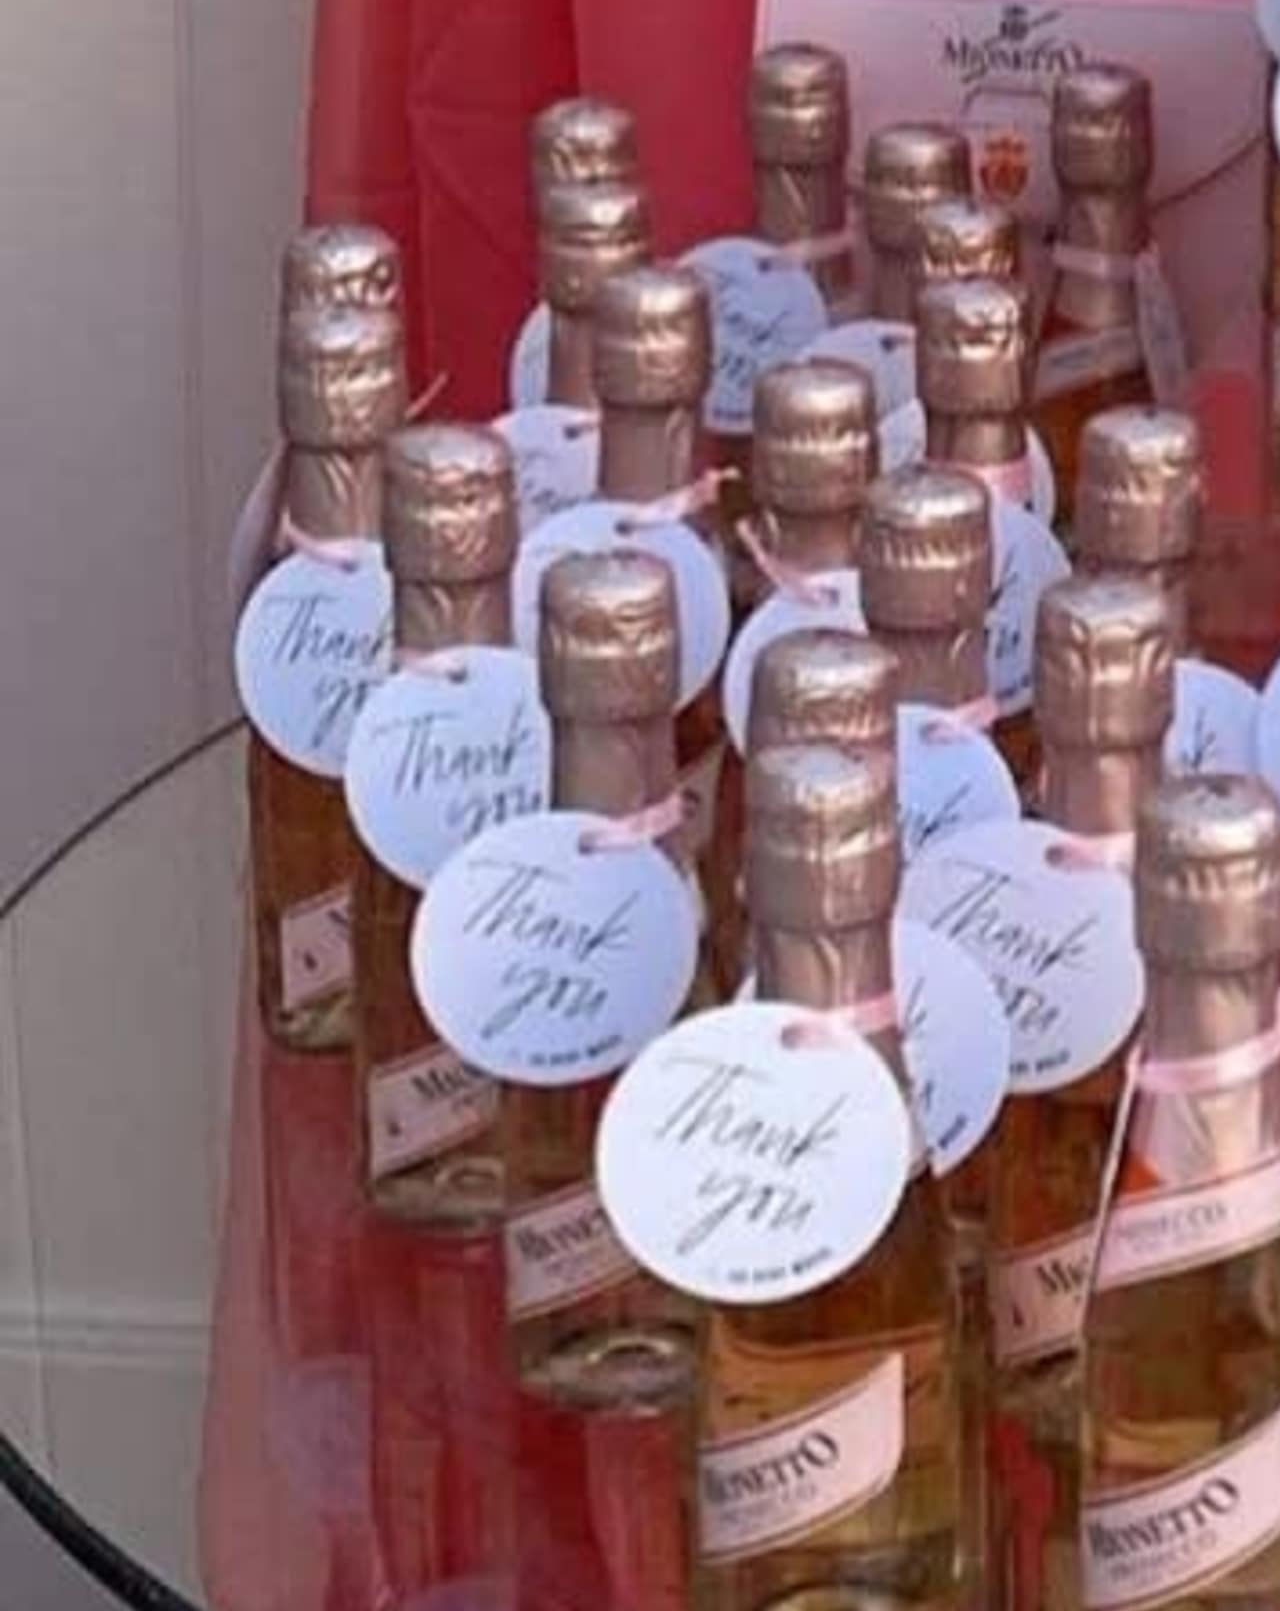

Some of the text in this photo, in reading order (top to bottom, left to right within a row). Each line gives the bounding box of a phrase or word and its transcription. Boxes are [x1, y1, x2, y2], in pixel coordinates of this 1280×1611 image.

[373, 695, 532, 794] Thank
[464, 858, 642, 963] Thank
[928, 855, 1099, 977] Thank
[482, 962, 609, 1041] you
[655, 1055, 851, 1169] Thank
[676, 1170, 815, 1255] you
